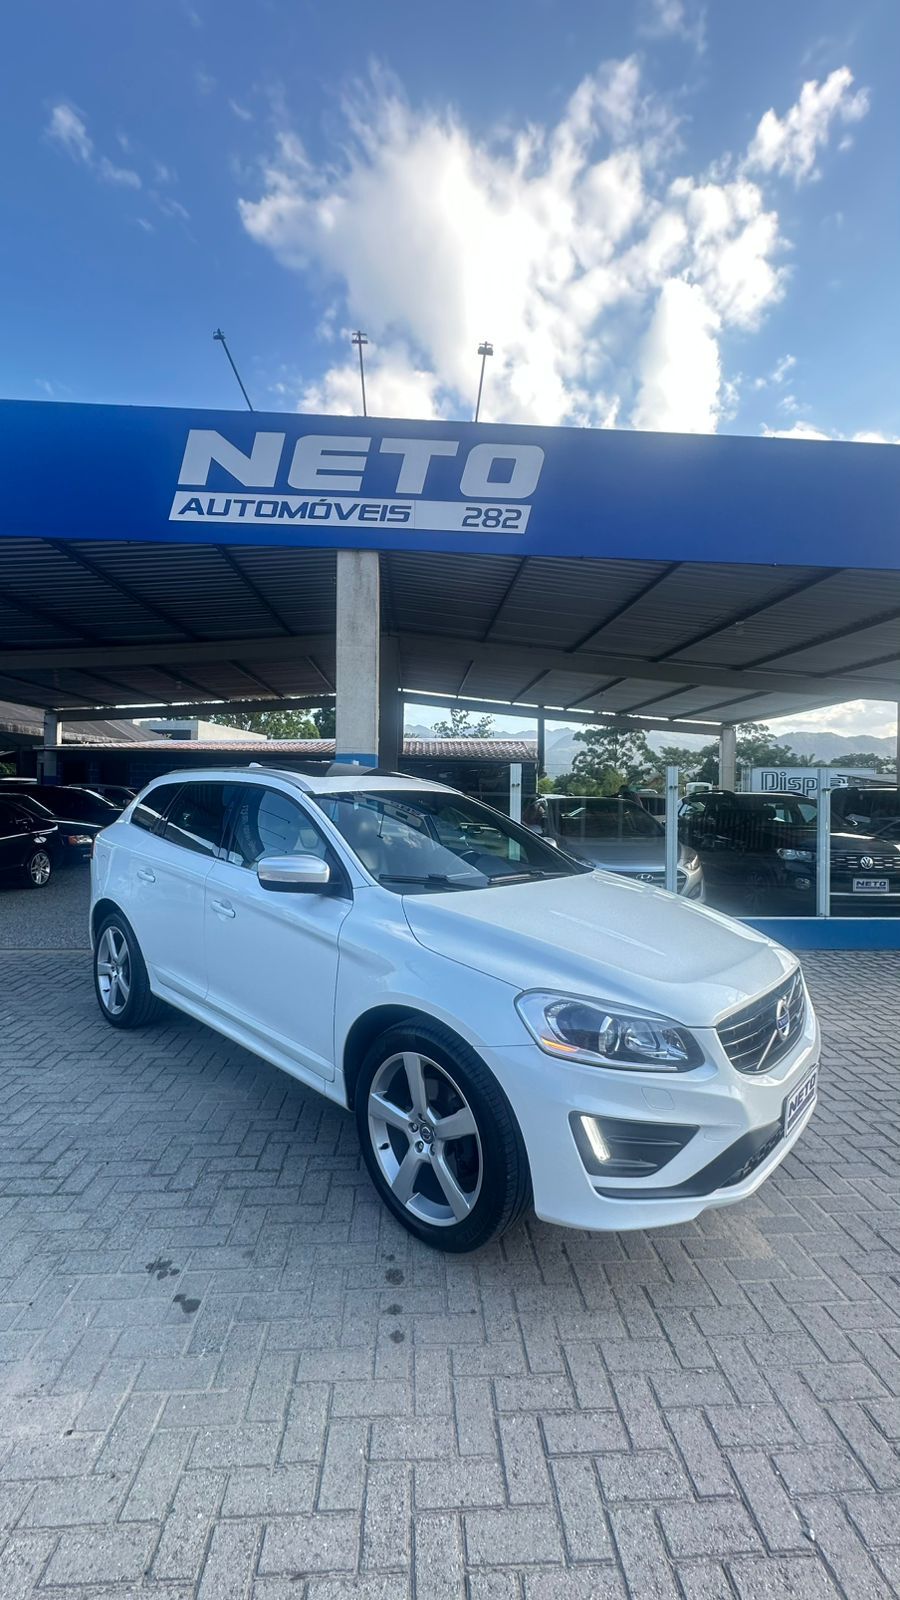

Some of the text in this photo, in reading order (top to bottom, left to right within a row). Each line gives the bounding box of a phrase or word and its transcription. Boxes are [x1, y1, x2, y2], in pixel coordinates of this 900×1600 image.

[177, 429, 545, 499] NETO
[178, 498, 522, 529] AUTOMÓVEIS 282
[789, 1074, 816, 1116] NETO
